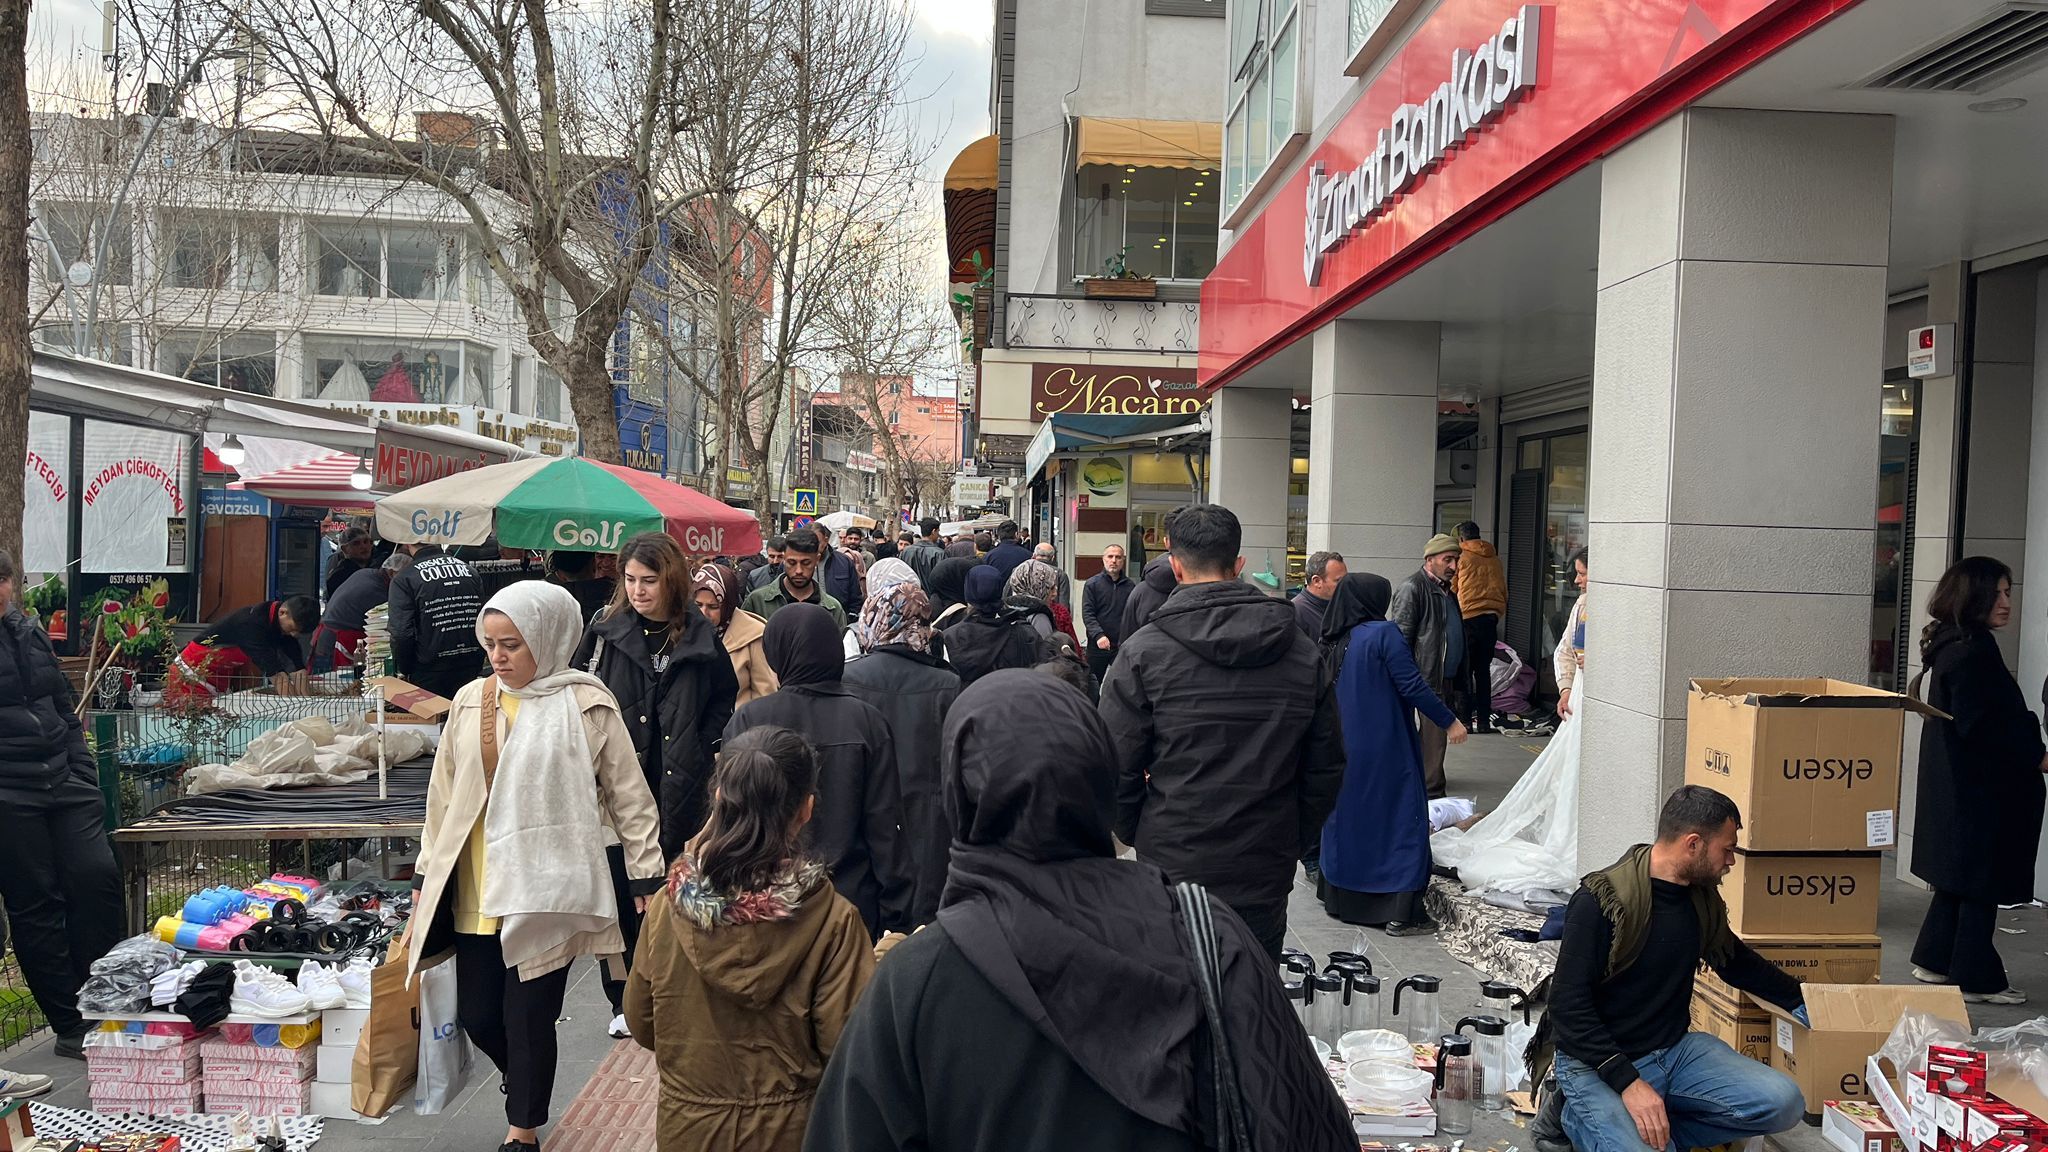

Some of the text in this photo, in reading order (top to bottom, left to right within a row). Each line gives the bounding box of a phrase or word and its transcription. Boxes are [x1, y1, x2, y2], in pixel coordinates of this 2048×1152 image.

[1320, 5, 1540, 253] Ziraat Bankası
[27, 451, 68, 502] FTECİSİ
[83, 460, 124, 507] MEYDAN
[411, 509, 463, 538] Golf
[553, 519, 627, 549] Golf
[685, 525, 725, 553] Golf
[414, 556, 447, 570] VERSACE
[419, 564, 472, 582] COUTURE
[109, 574, 153, 584] 0537 496 06 57
[482, 690, 495, 745] GUESS
[1783, 758, 1873, 788] eksen
[1766, 875, 1856, 904] eksen
[1785, 959, 1807, 968] BOWL
[1809, 959, 1819, 968] 10
[1746, 1035, 1771, 1043] LOND
